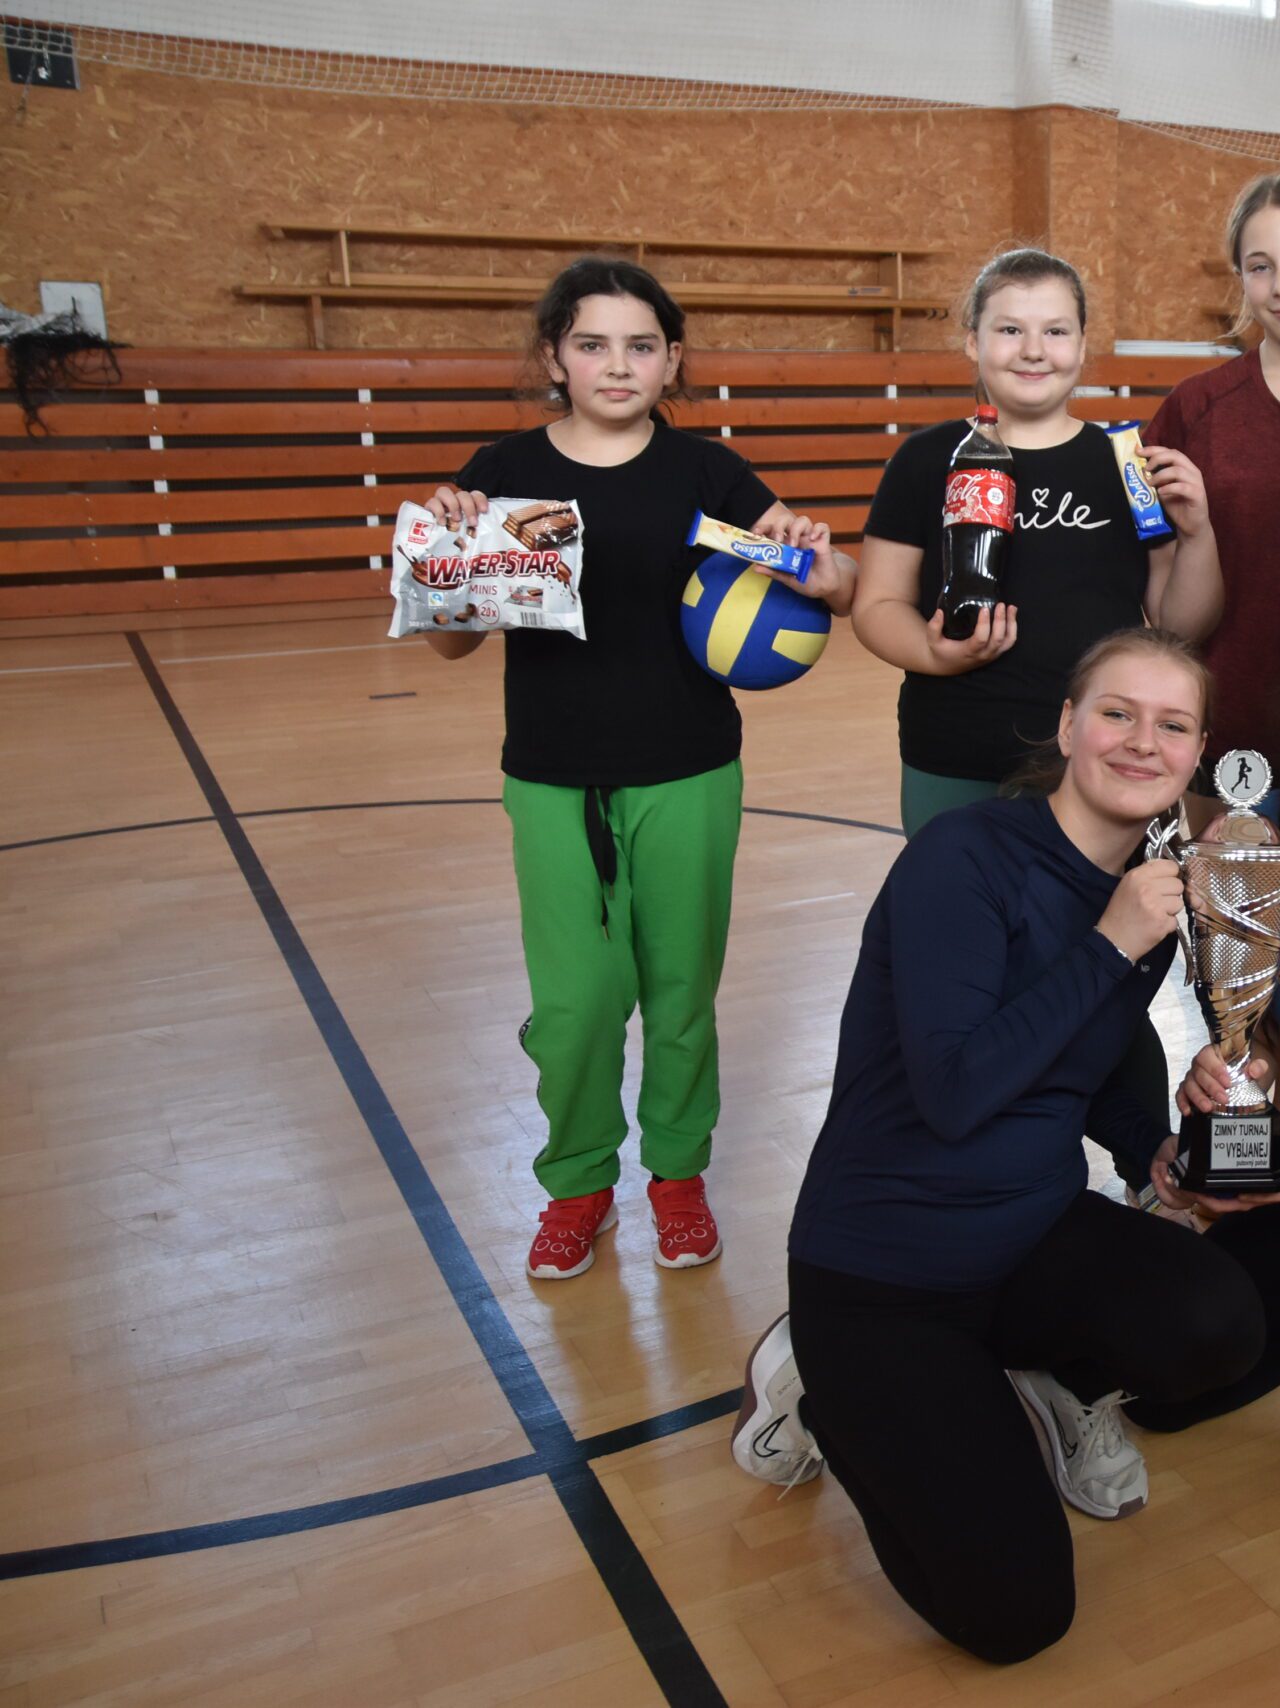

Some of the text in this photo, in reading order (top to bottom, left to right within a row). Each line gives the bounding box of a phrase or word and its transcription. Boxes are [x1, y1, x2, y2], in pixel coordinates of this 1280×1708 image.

[946, 474, 986, 504] Cola
[1126, 463, 1151, 504] Delissa
[733, 541, 777, 561] Delissa
[468, 584, 498, 596] MINIS
[1214, 1121, 1269, 1136] ZIMNÝ TURNAJ
[1226, 1138, 1269, 1158] VYBÍJANEJ
